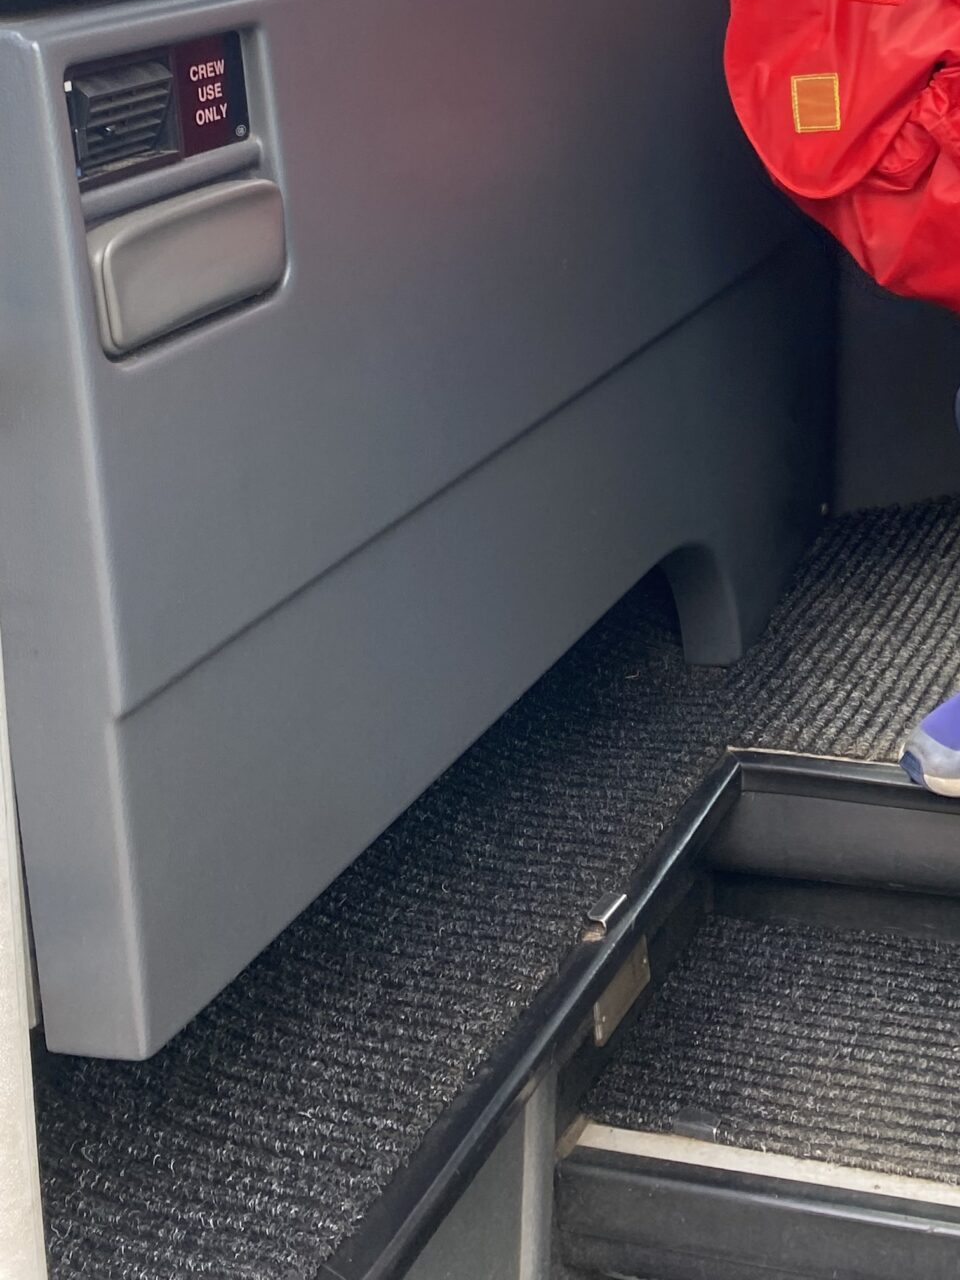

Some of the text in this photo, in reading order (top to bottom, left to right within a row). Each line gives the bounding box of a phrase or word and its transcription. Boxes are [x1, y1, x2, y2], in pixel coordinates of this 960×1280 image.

[189, 58, 225, 82] CREW
[197, 82, 223, 102] USE
[195, 102, 228, 126] ONLY
